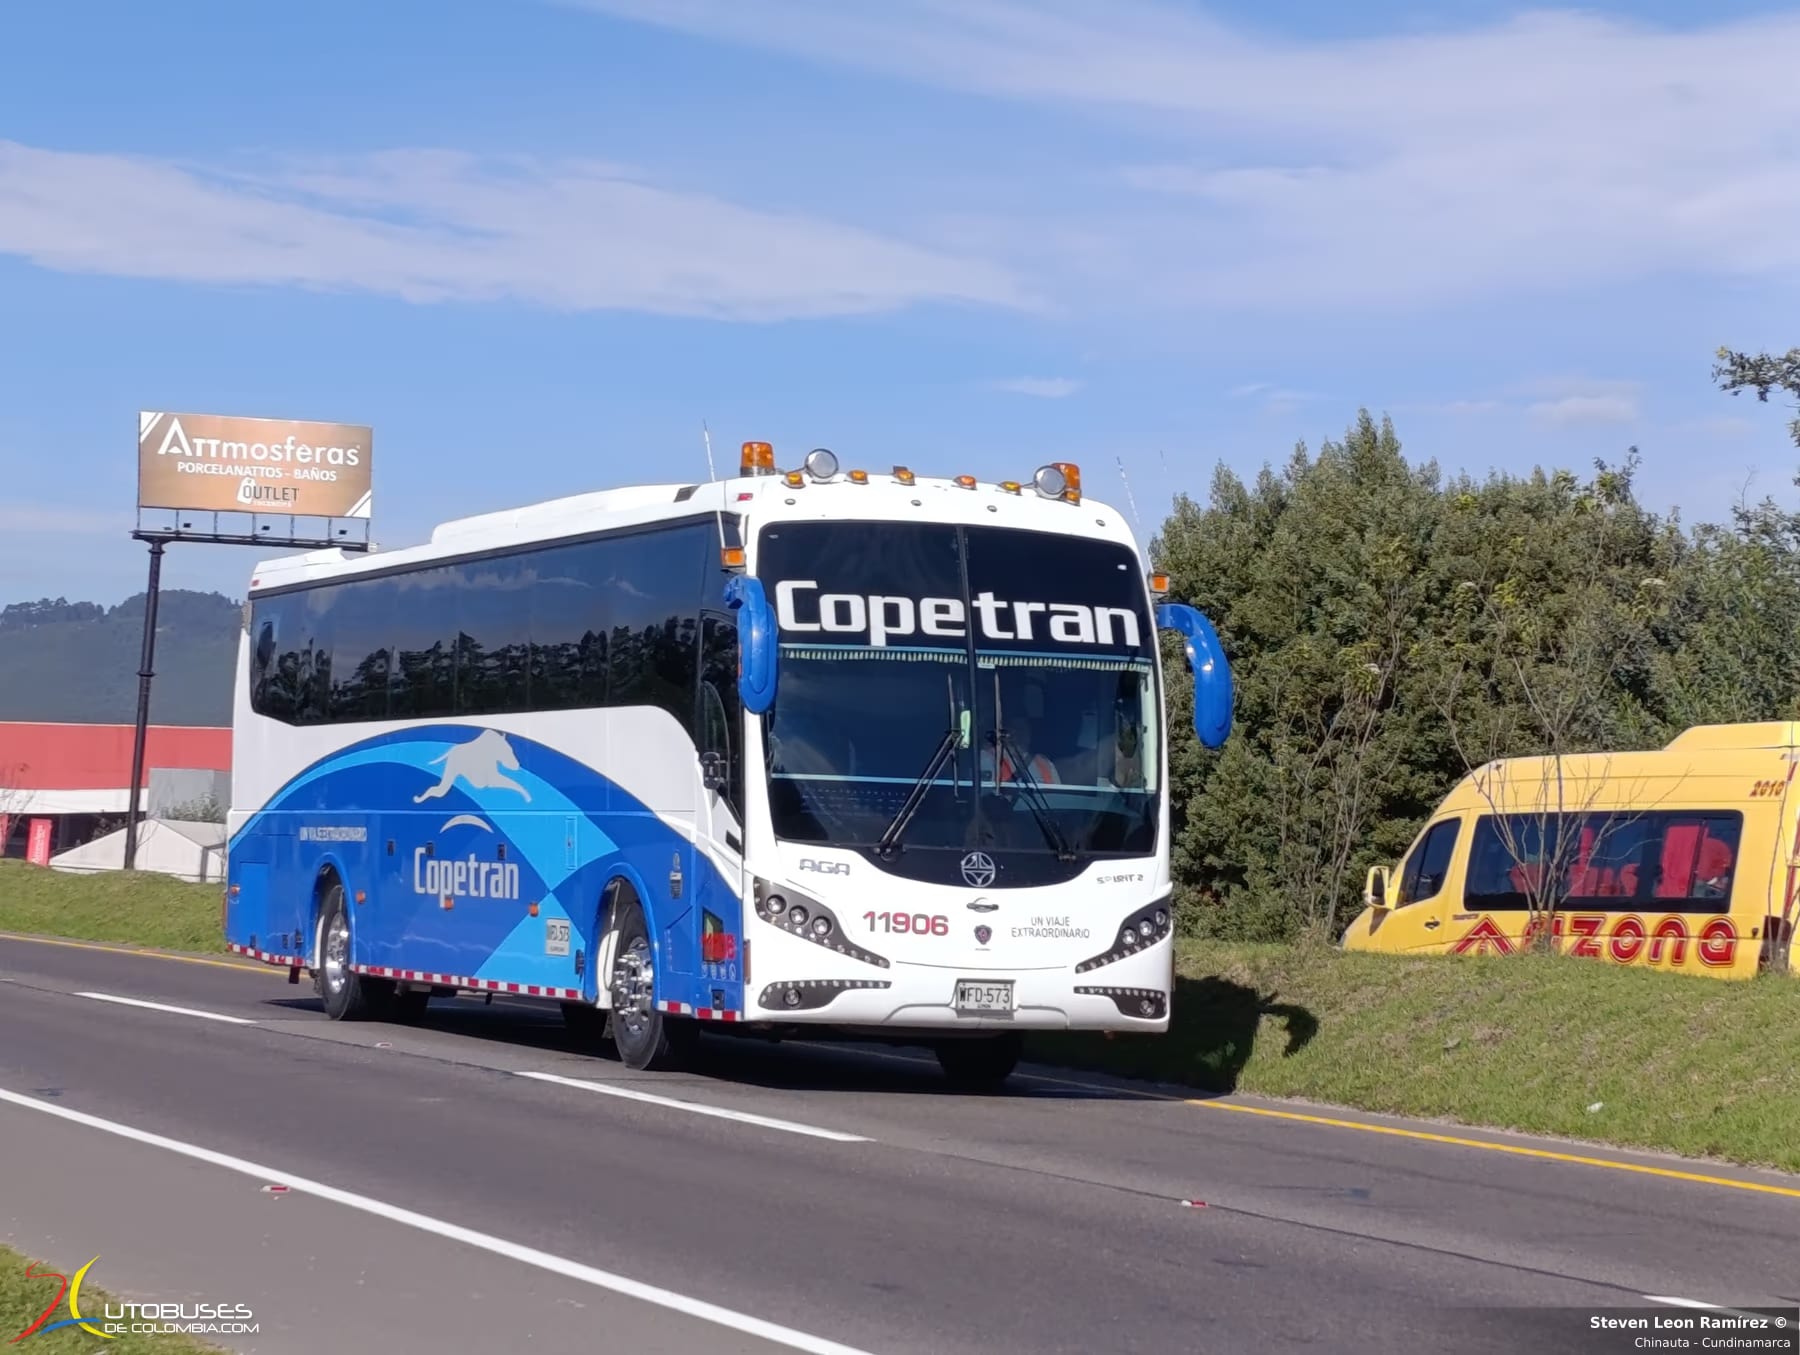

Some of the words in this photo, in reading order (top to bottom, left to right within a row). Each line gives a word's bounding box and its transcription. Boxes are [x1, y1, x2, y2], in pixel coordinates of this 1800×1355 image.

[176, 461, 283, 479] PORCELANATTOS
[294, 466, 337, 482] BAÑOS
[243, 485, 299, 501] OUTLET
[775, 580, 1140, 646] Copetran
[799, 858, 850, 876] AGA
[414, 847, 519, 908] Copetran
[863, 911, 949, 936] 11906
[1030, 916, 1043, 926] UN
[1046, 916, 1071, 926] VIAJE
[1011, 927, 1090, 939] EXTRAORDINARIO
[959, 987, 1010, 1004] WFD-573
